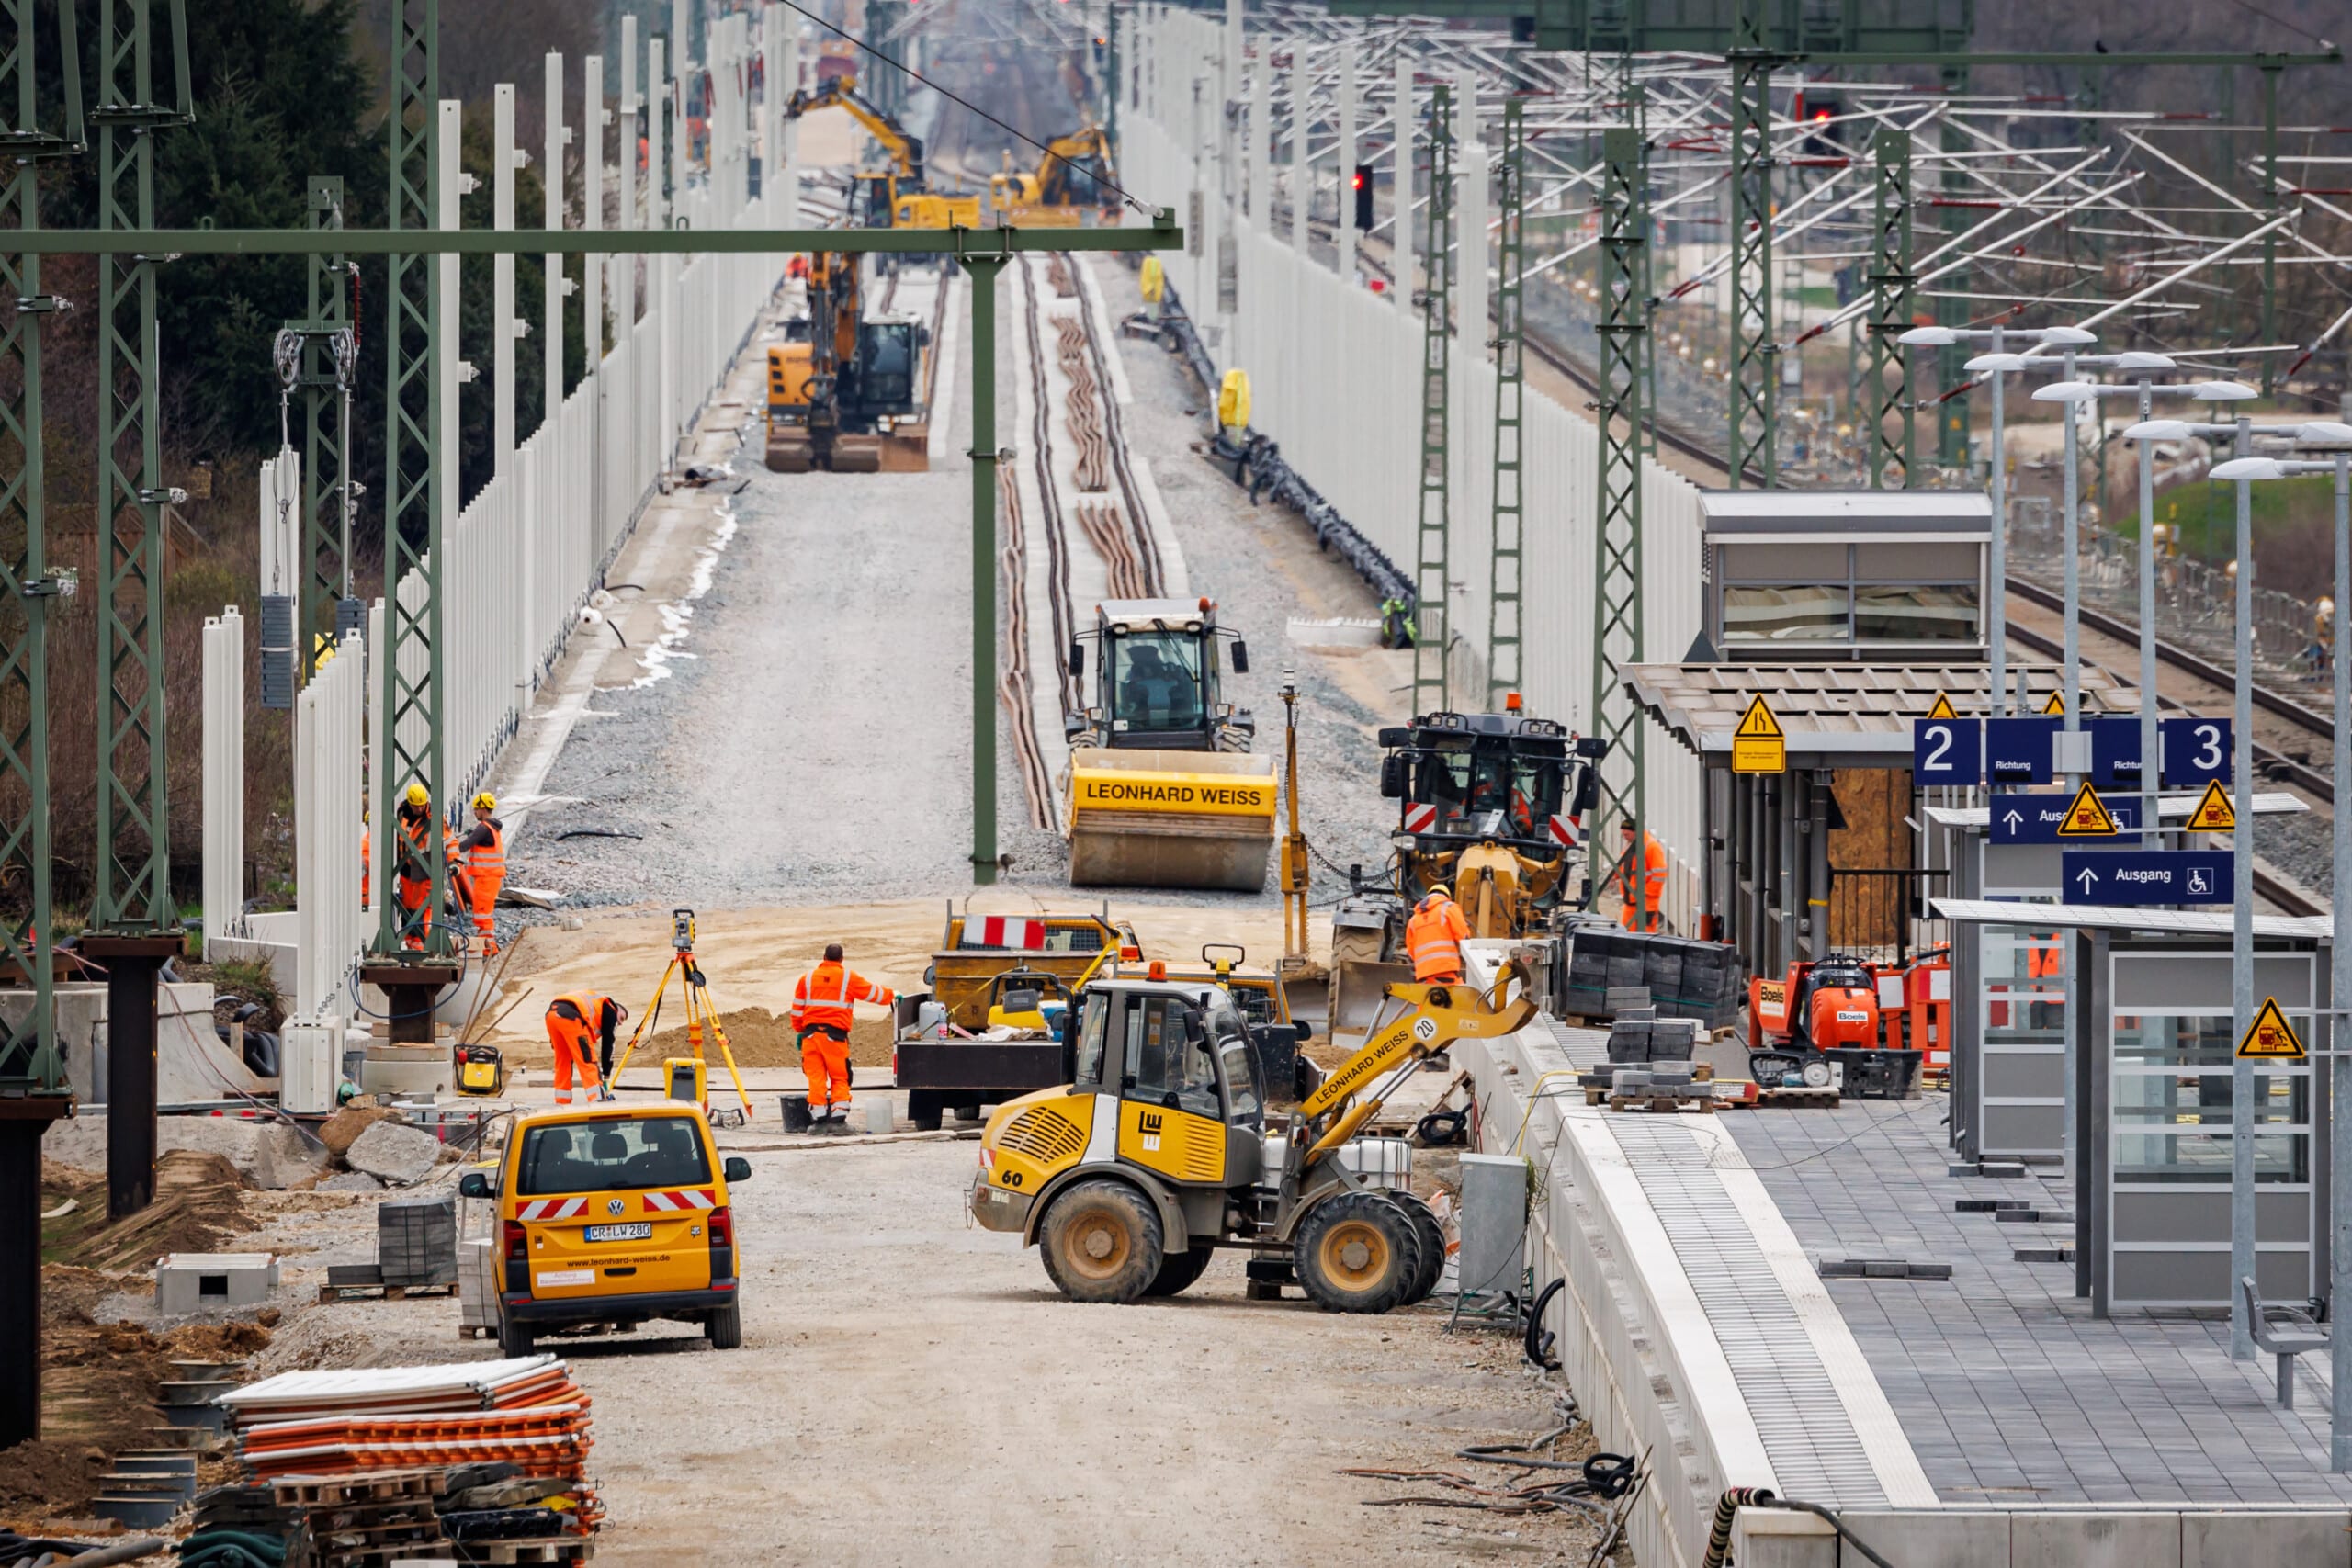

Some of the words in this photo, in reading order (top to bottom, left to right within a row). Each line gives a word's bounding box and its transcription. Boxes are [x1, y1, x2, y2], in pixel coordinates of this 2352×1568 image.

[1923, 725, 1953, 771] 2
[2192, 724, 2222, 770] 3
[1995, 761, 2031, 771] Richtung
[2113, 761, 2142, 770] Richtu
[1087, 783, 1194, 803] LEONHARD
[1201, 788, 1261, 806] WEISS
[2115, 868, 2172, 884] Ausgang
[1760, 986, 1784, 1004] Boels
[1838, 1012, 1867, 1021] Boels
[1416, 1020, 1435, 1039] 20
[1315, 1056, 1374, 1105] LEONHARD
[1373, 1030, 1410, 1060] WEISS
[1001, 1169, 1023, 1188] 60
[591, 1227, 605, 1238] CR
[613, 1225, 628, 1236] LW
[629, 1224, 650, 1235] 280
[566, 1254, 671, 1268] www.leonhard-weiss.de
